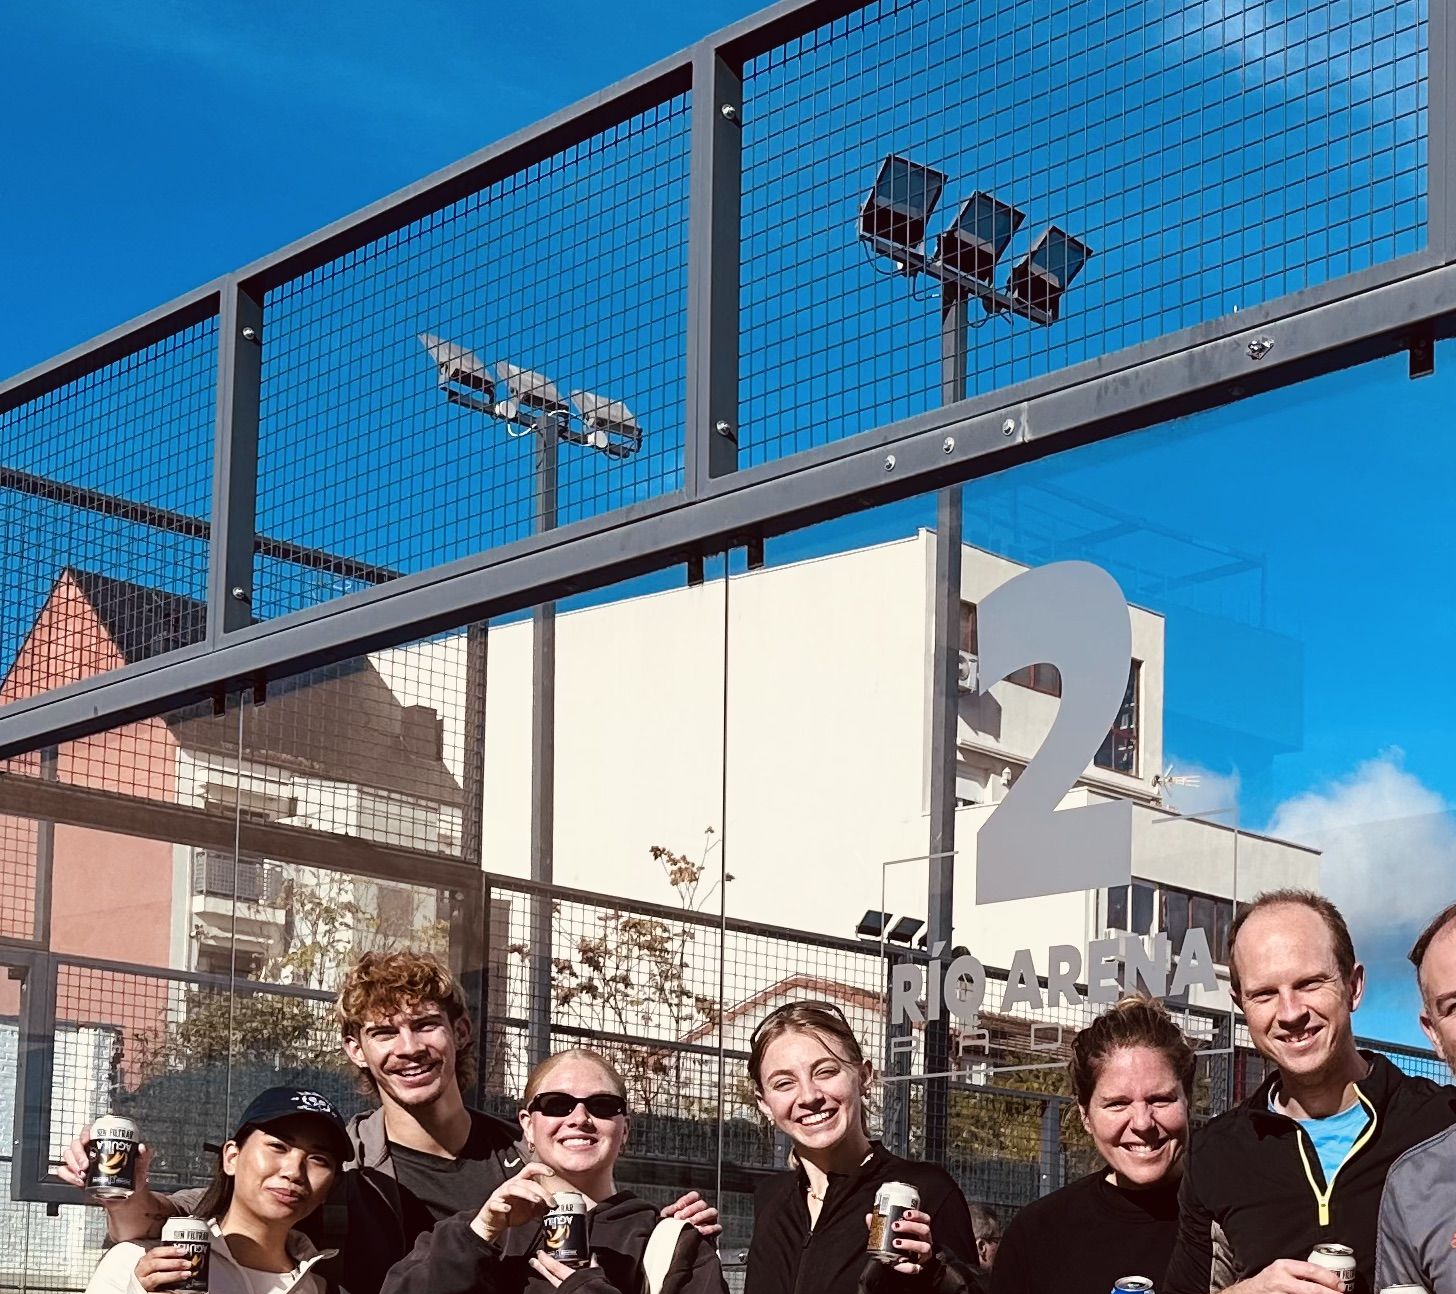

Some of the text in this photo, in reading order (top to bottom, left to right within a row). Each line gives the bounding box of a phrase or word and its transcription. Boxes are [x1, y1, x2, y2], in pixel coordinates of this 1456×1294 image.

[976, 560, 1132, 905] 2
[891, 927, 1219, 1025] RÍO ARENA
